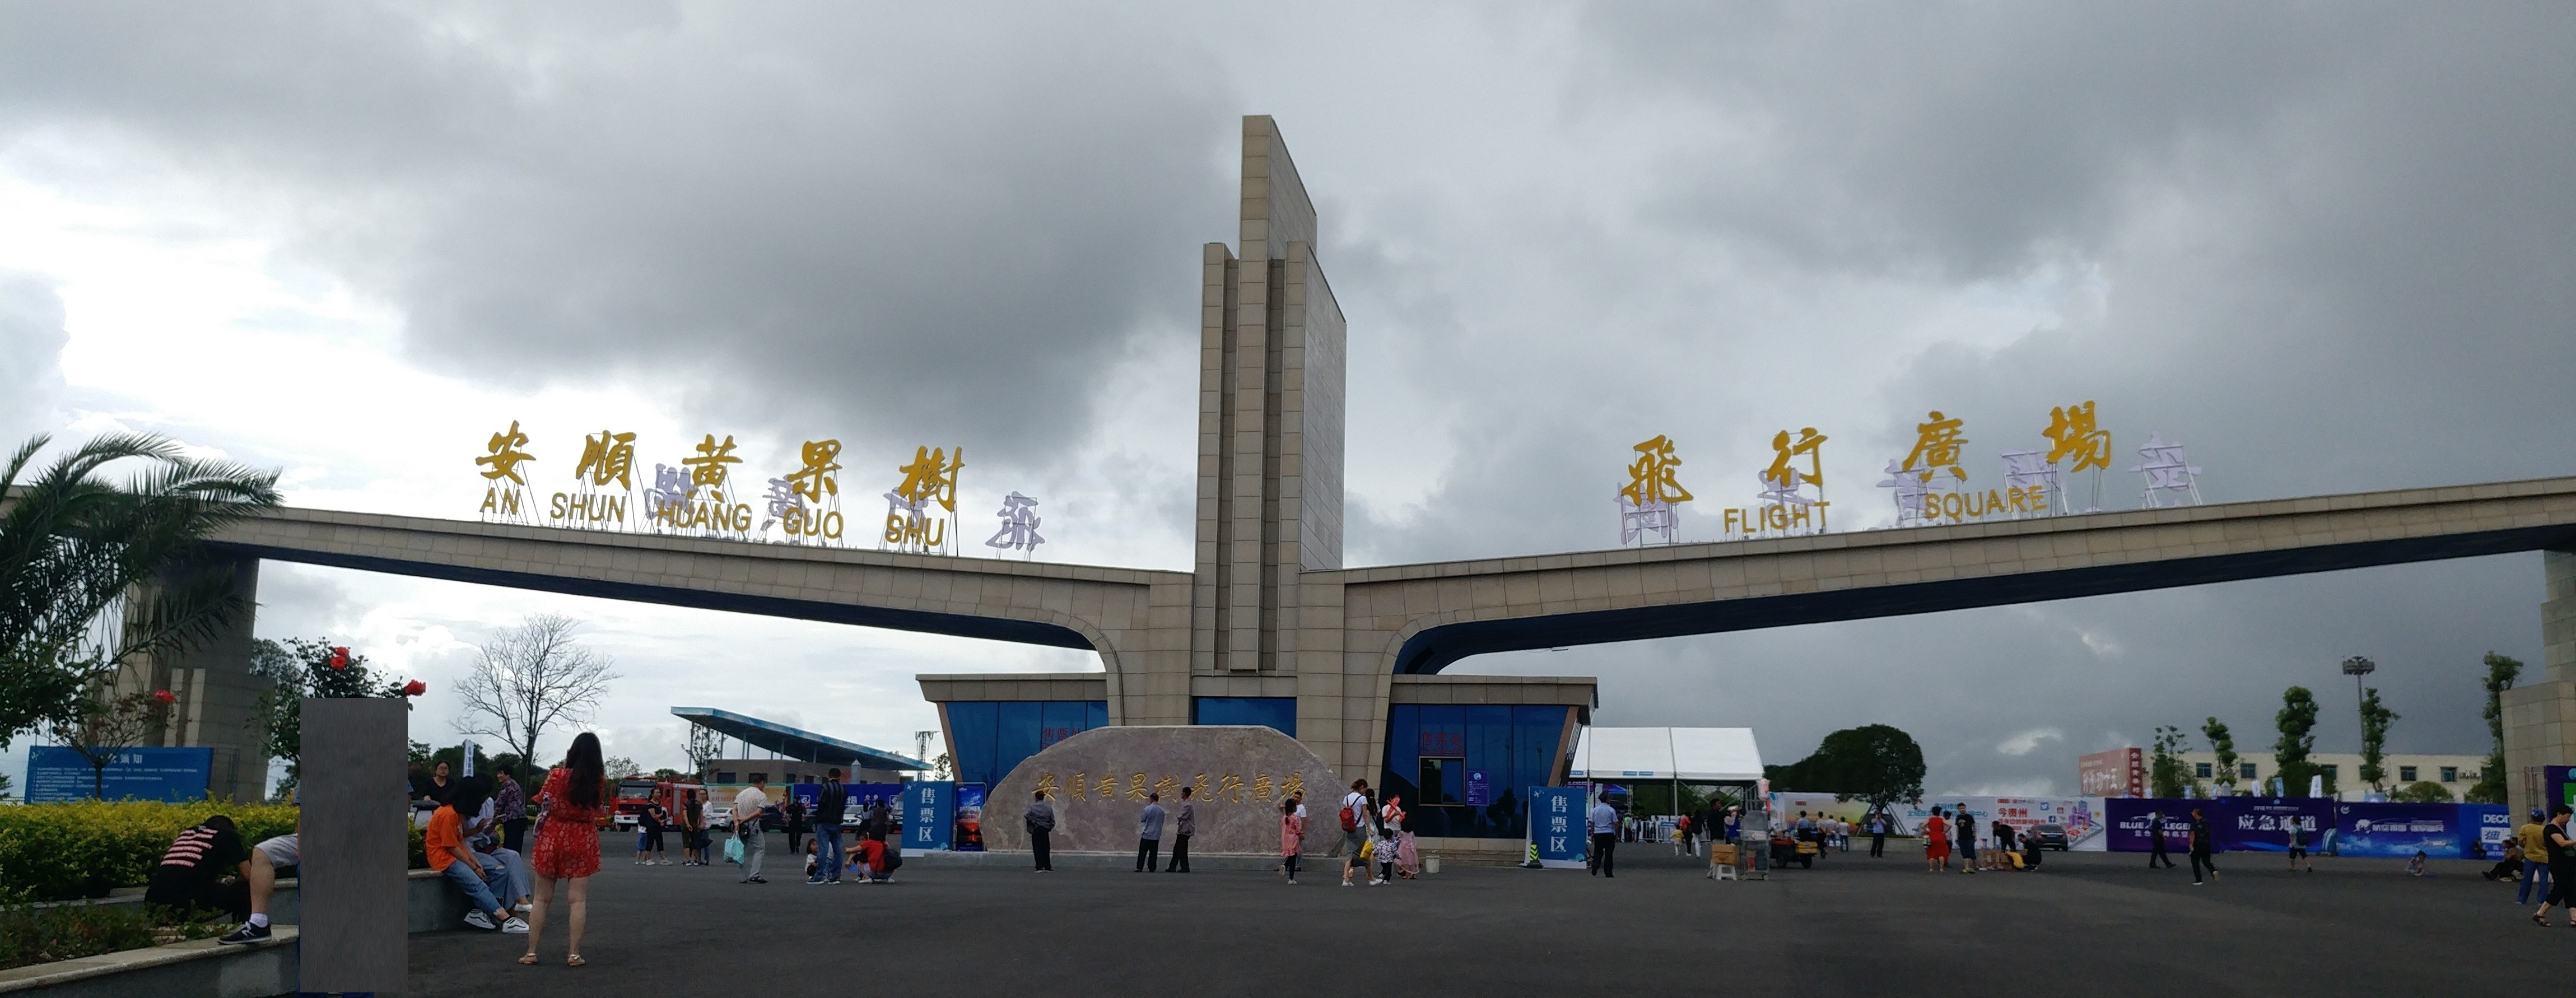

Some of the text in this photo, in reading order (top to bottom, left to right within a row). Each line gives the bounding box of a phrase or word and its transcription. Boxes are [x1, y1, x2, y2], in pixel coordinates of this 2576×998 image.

[1621, 400, 2111, 505] 飛行廣場
[479, 487, 944, 547] AN SHUN HUANG GUO SHU
[1723, 501, 1829, 534] FLIGHT
[1923, 484, 2048, 524] SQUARE
[919, 787, 937, 842] 售票区
[1550, 794, 1568, 854] 售票区
